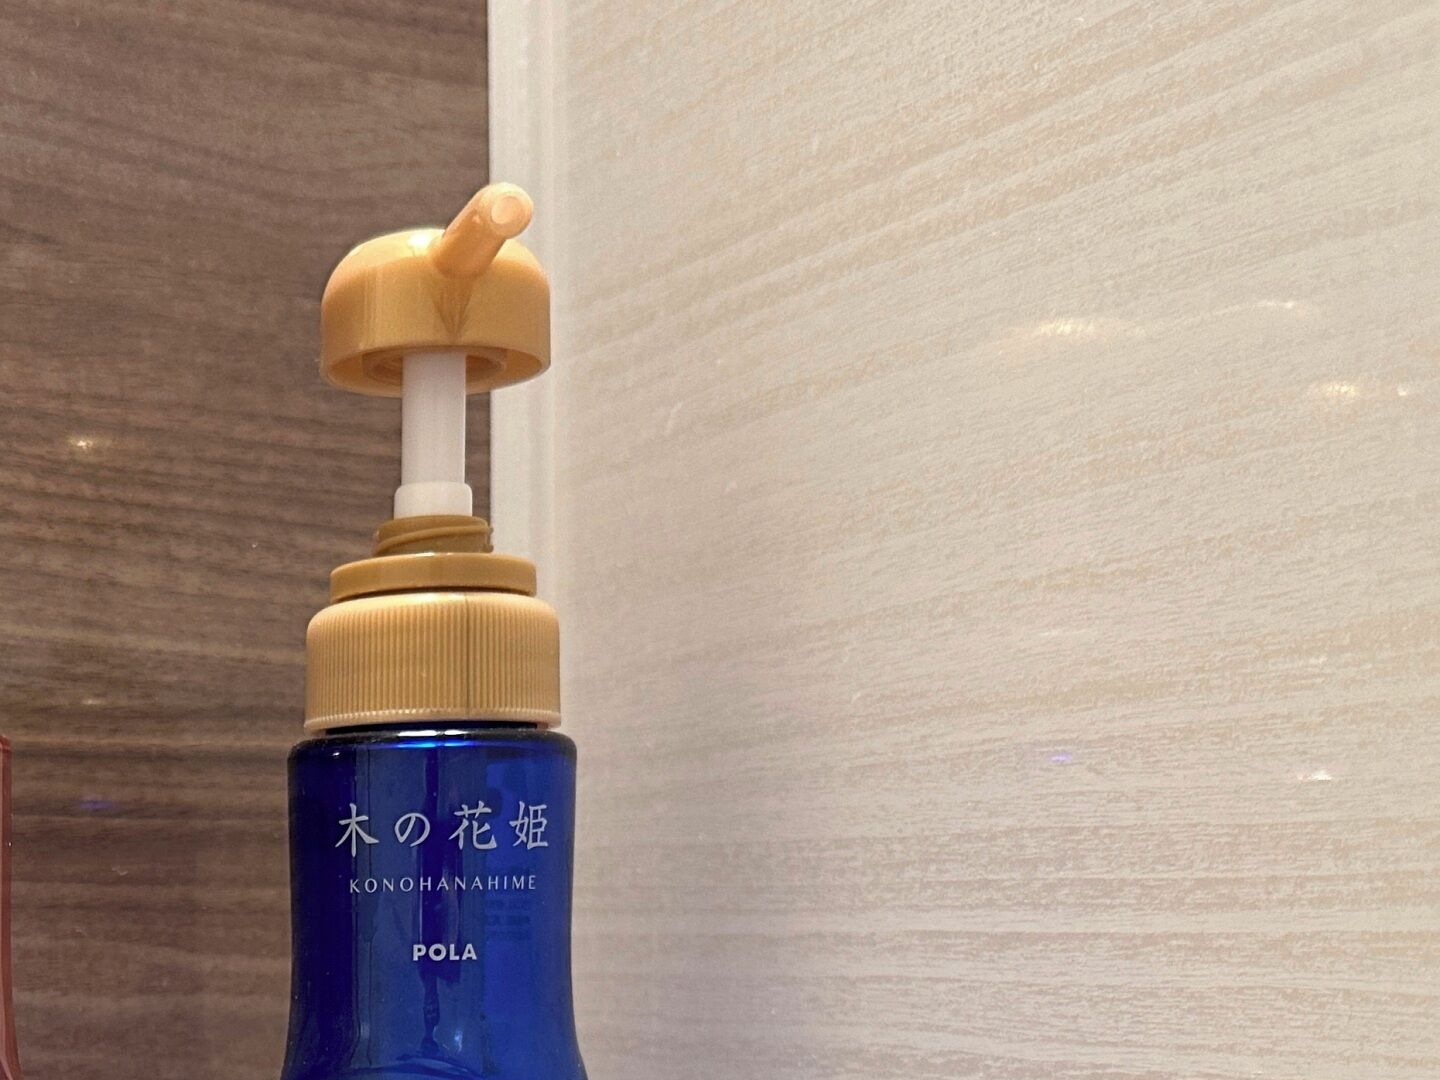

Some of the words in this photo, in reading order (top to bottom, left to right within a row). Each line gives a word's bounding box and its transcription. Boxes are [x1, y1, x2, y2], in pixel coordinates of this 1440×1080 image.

[334, 800, 549, 858] 木の花姫
[349, 875, 537, 893] KONOHANAHIME
[412, 943, 478, 961] POLA
